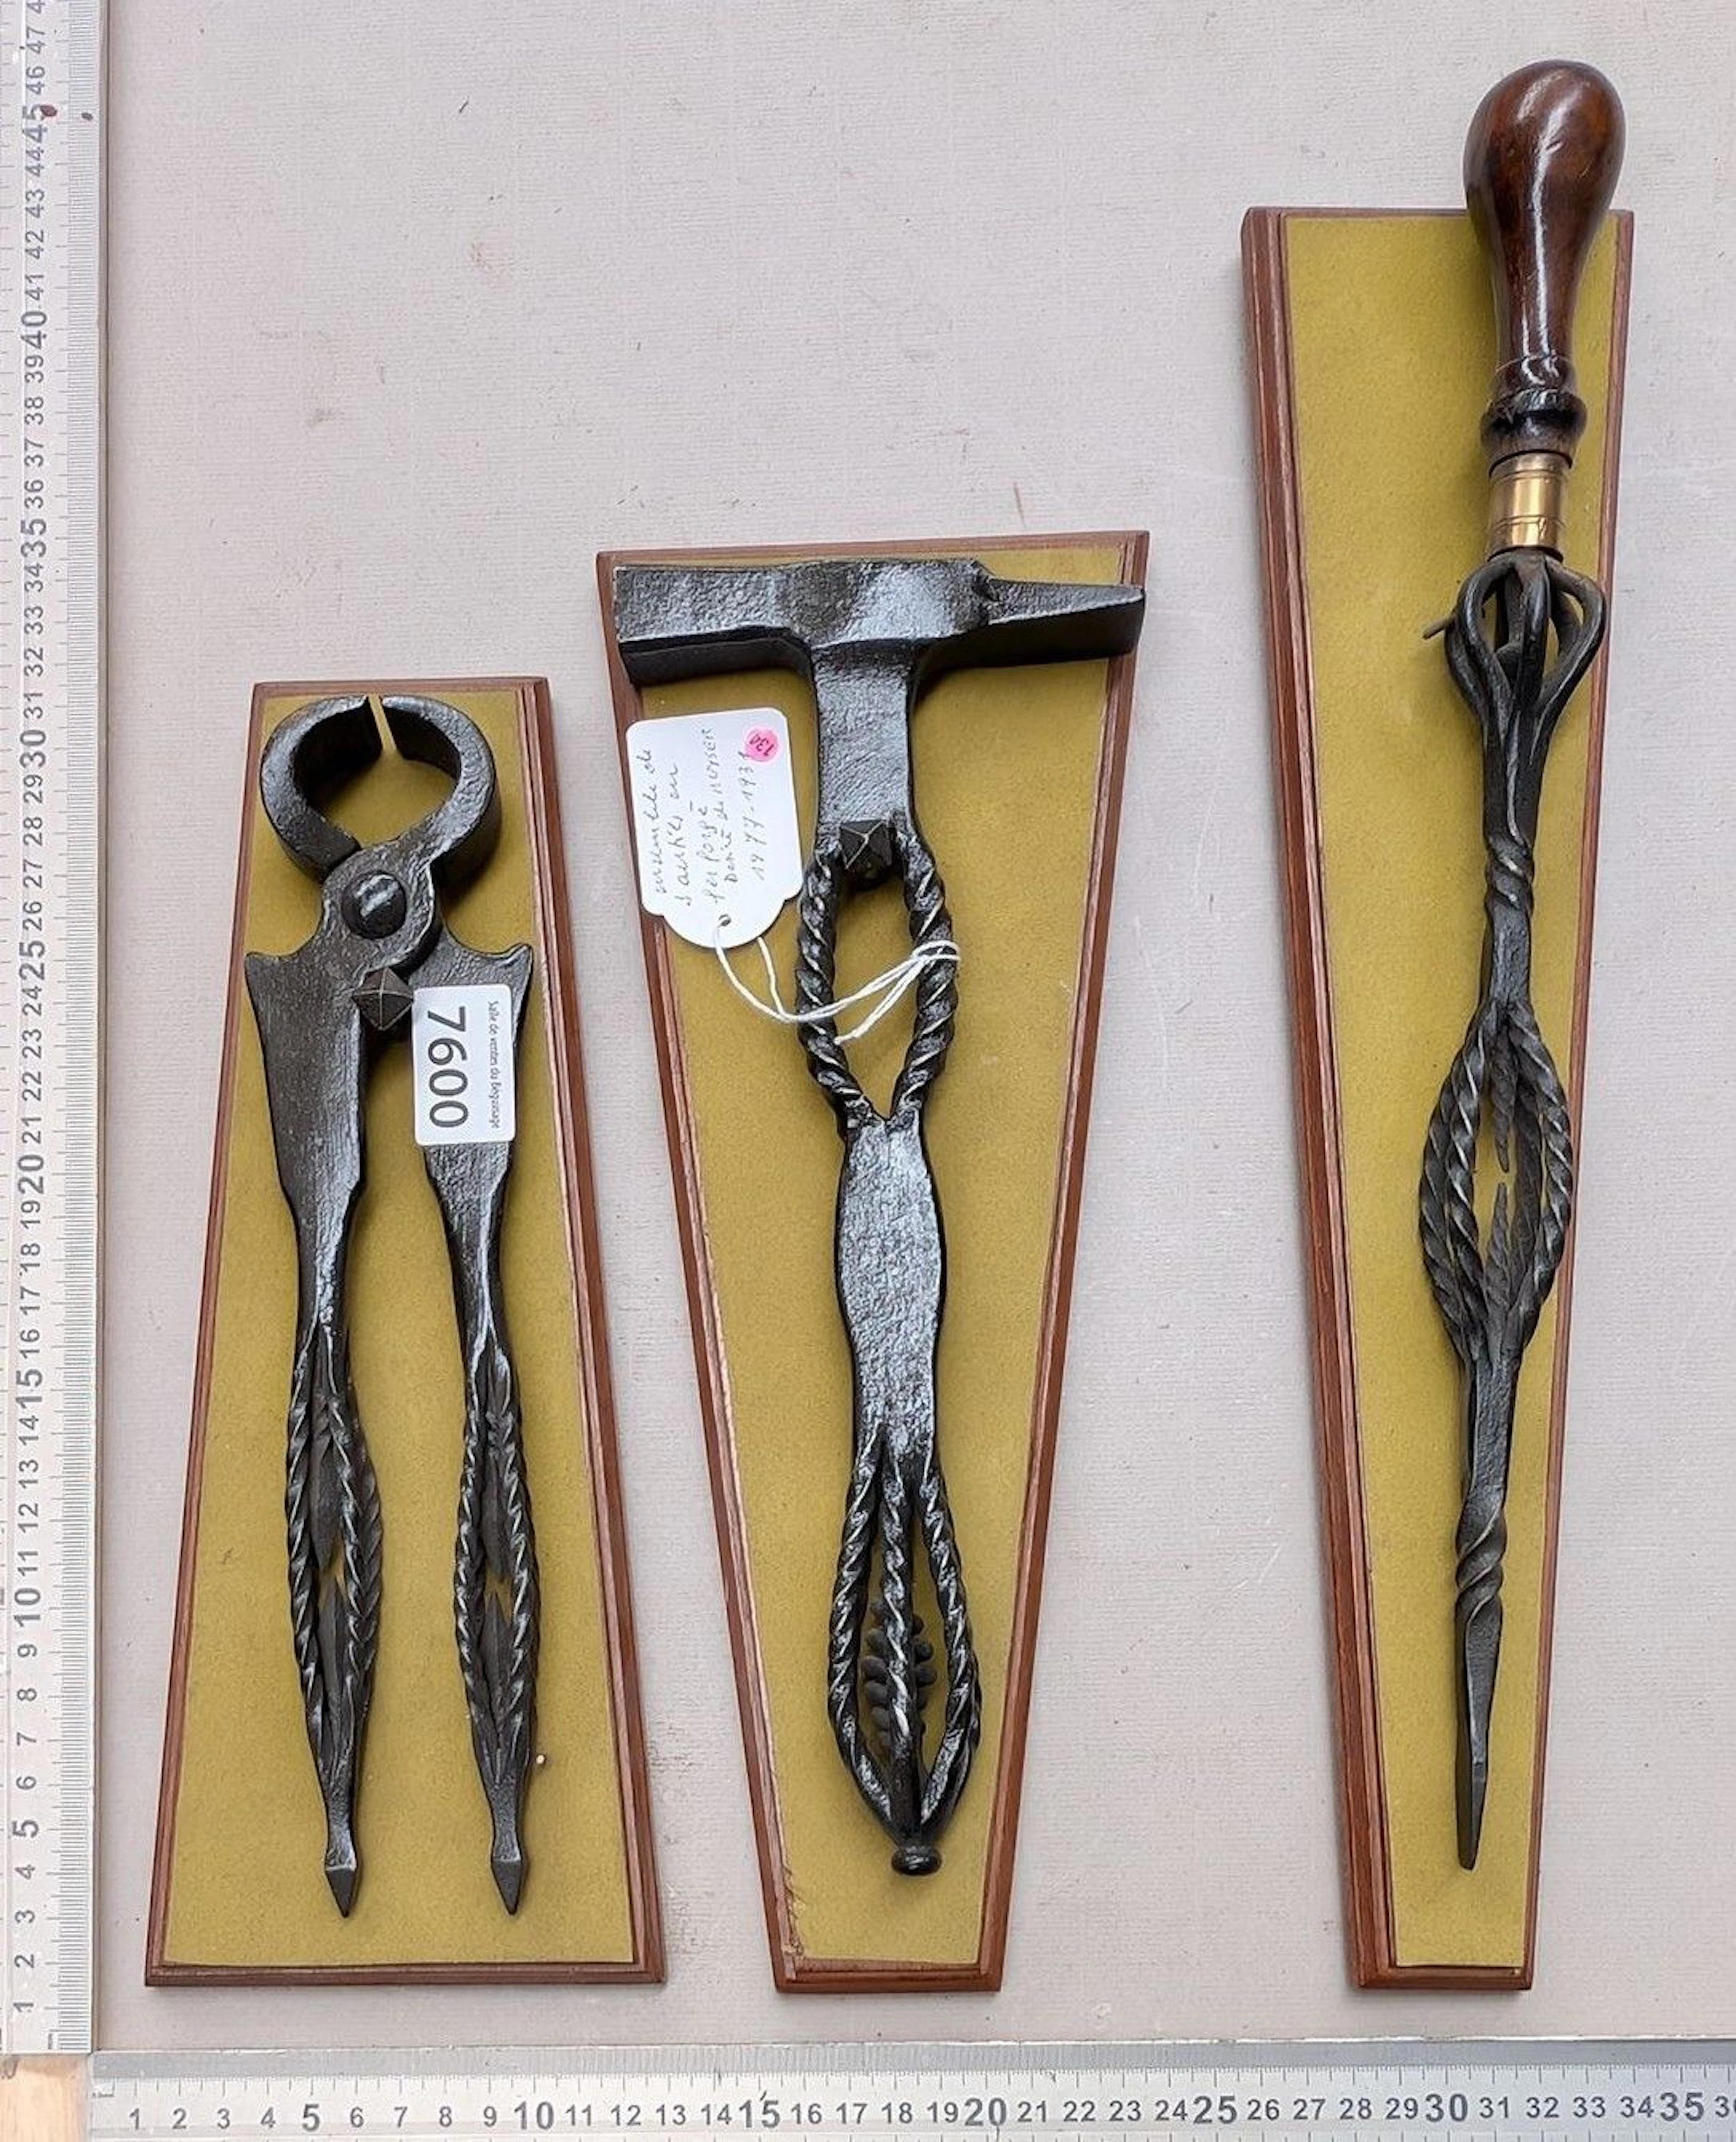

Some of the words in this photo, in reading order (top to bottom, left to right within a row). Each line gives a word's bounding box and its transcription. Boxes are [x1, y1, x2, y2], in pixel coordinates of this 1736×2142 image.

[26, 24, 46, 54] 47
[26, 66, 45, 95] 46
[22, 104, 48, 143] 45
[25, 147, 45, 177] 44
[25, 189, 45, 218] 43
[24, 230, 44, 260] 42
[24, 274, 44, 301] 41
[20, 311, 47, 350] 40
[24, 355, 44, 384] 39
[24, 396, 44, 425] 38
[24, 437, 44, 468] 37
[24, 480, 44, 509] 36
[20, 519, 47, 558] 35
[24, 563, 44, 593] 34
[24, 605, 43, 635] 33
[24, 647, 43, 677] 32
[23, 693, 43, 719] 31
[19, 729, 46, 769] 30
[23, 774, 43, 804] 29
[23, 817, 43, 846] 28
[23, 859, 42, 889] 27
[22, 901, 42, 932] 26
[18, 941, 46, 981] 25
[21, 985, 42, 1017] 24
[21, 1029, 42, 1059] 23
[489, 1024, 500, 1035] de
[428, 1006, 468, 1128] 7600
[490, 1068, 500, 1080] du
[20, 1071, 42, 1102] 22
[20, 1117, 42, 1144] 21
[16, 1154, 44, 1195] 20
[20, 1200, 41, 1229] 19
[19, 1243, 40, 1272] 18
[19, 1286, 40, 1315] 17
[18, 1329, 40, 1359] 16
[14, 1369, 43, 1409] 15
[18, 1415, 39, 1446] 14
[18, 1459, 38, 1489] 13
[18, 1503, 38, 1533] 12
[17, 1551, 38, 1577] 11
[13, 1588, 41, 1627] 10
[17, 1644, 38, 1658] 9
[16, 1688, 37, 1702] 8
[16, 1732, 37, 1746] 7
[16, 1776, 37, 1790] 6
[11, 1820, 39, 1838] 5
[14, 1864, 36, 1880] 4
[14, 1910, 35, 1924] 3
[14, 1954, 35, 1969] 2
[13, 2002, 34, 2013] 1
[129, 2108, 139, 2130] 1
[172, 2108, 186, 2129] 2
[217, 2108, 230, 2129] 3
[260, 2107, 276, 2129] 4
[302, 2104, 321, 2133] 5
[350, 2106, 364, 2129] 6
[394, 2106, 408, 2129] 7
[439, 2106, 453, 2128] 8
[483, 2105, 497, 2128] 9
[514, 2101, 554, 2131] 10
[565, 2104, 591, 2127] 11
[611, 2104, 642, 2127] 12
[656, 2104, 686, 2126] 13
[701, 2104, 732, 2126] 14
[739, 2099, 780, 2129] 15
[791, 2103, 822, 2125] 16
[836, 2102, 868, 2125] 17
[882, 2102, 913, 2124] 18
[927, 2101, 958, 2123] 19
[964, 2097, 1007, 2127] 20
[1017, 2100, 1046, 2123] 21
[1063, 2100, 1096, 2123] 22
[1108, 2100, 1142, 2122] 23
[1155, 2099, 1188, 2121] 24
[1193, 2095, 1237, 2125] 25
[1247, 2099, 1279, 2121] 26
[1293, 2098, 1326, 2121] 27
[1340, 2097, 1372, 2120] 28
[1385, 2097, 1418, 2120] 29
[1425, 2093, 1468, 2123] 30
[1479, 2096, 1509, 2119] 31
[1526, 2096, 1560, 2118] 32
[1573, 2096, 1606, 2118] 33
[1620, 2095, 1654, 2118] 34
[1660, 2092, 1704, 2122] 35
[1714, 2096, 1736, 2118] 3
